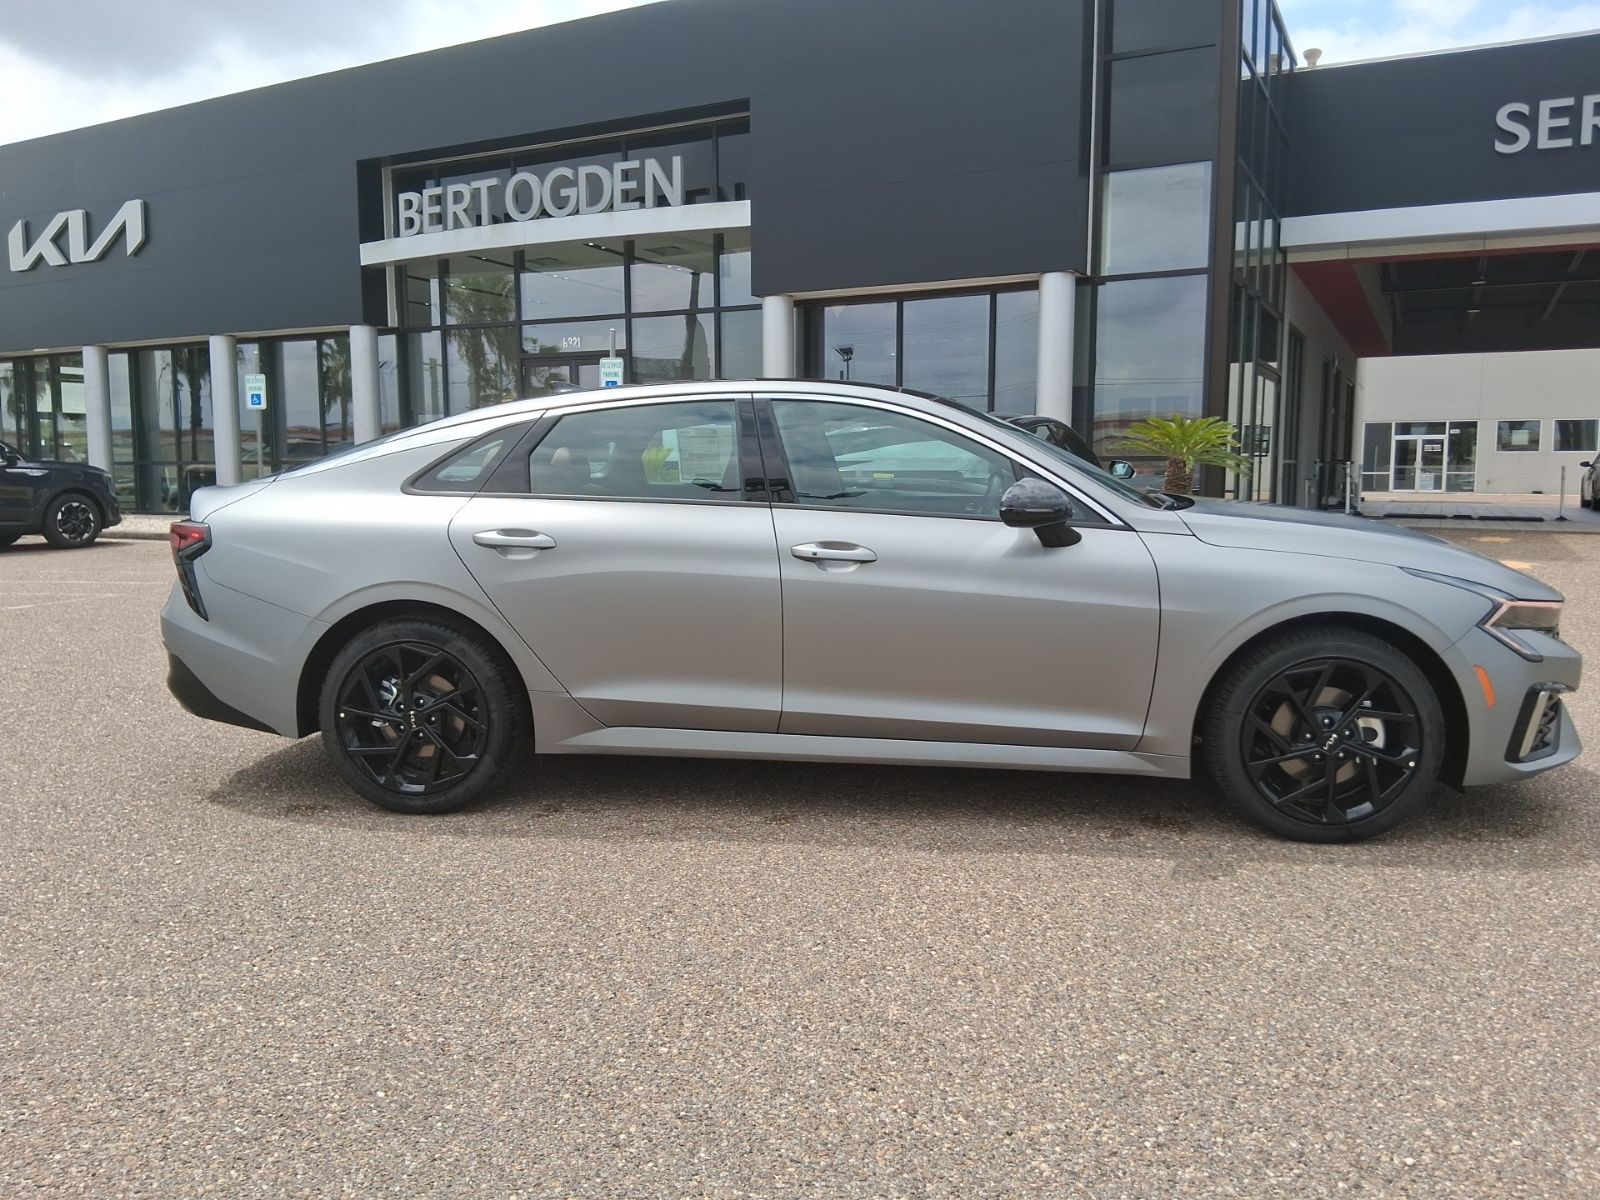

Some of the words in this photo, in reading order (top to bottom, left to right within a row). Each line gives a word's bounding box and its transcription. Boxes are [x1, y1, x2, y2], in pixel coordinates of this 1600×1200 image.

[8, 199, 145, 272] KIA
[398, 177, 501, 238] BERT
[505, 155, 685, 222] OGDEN
